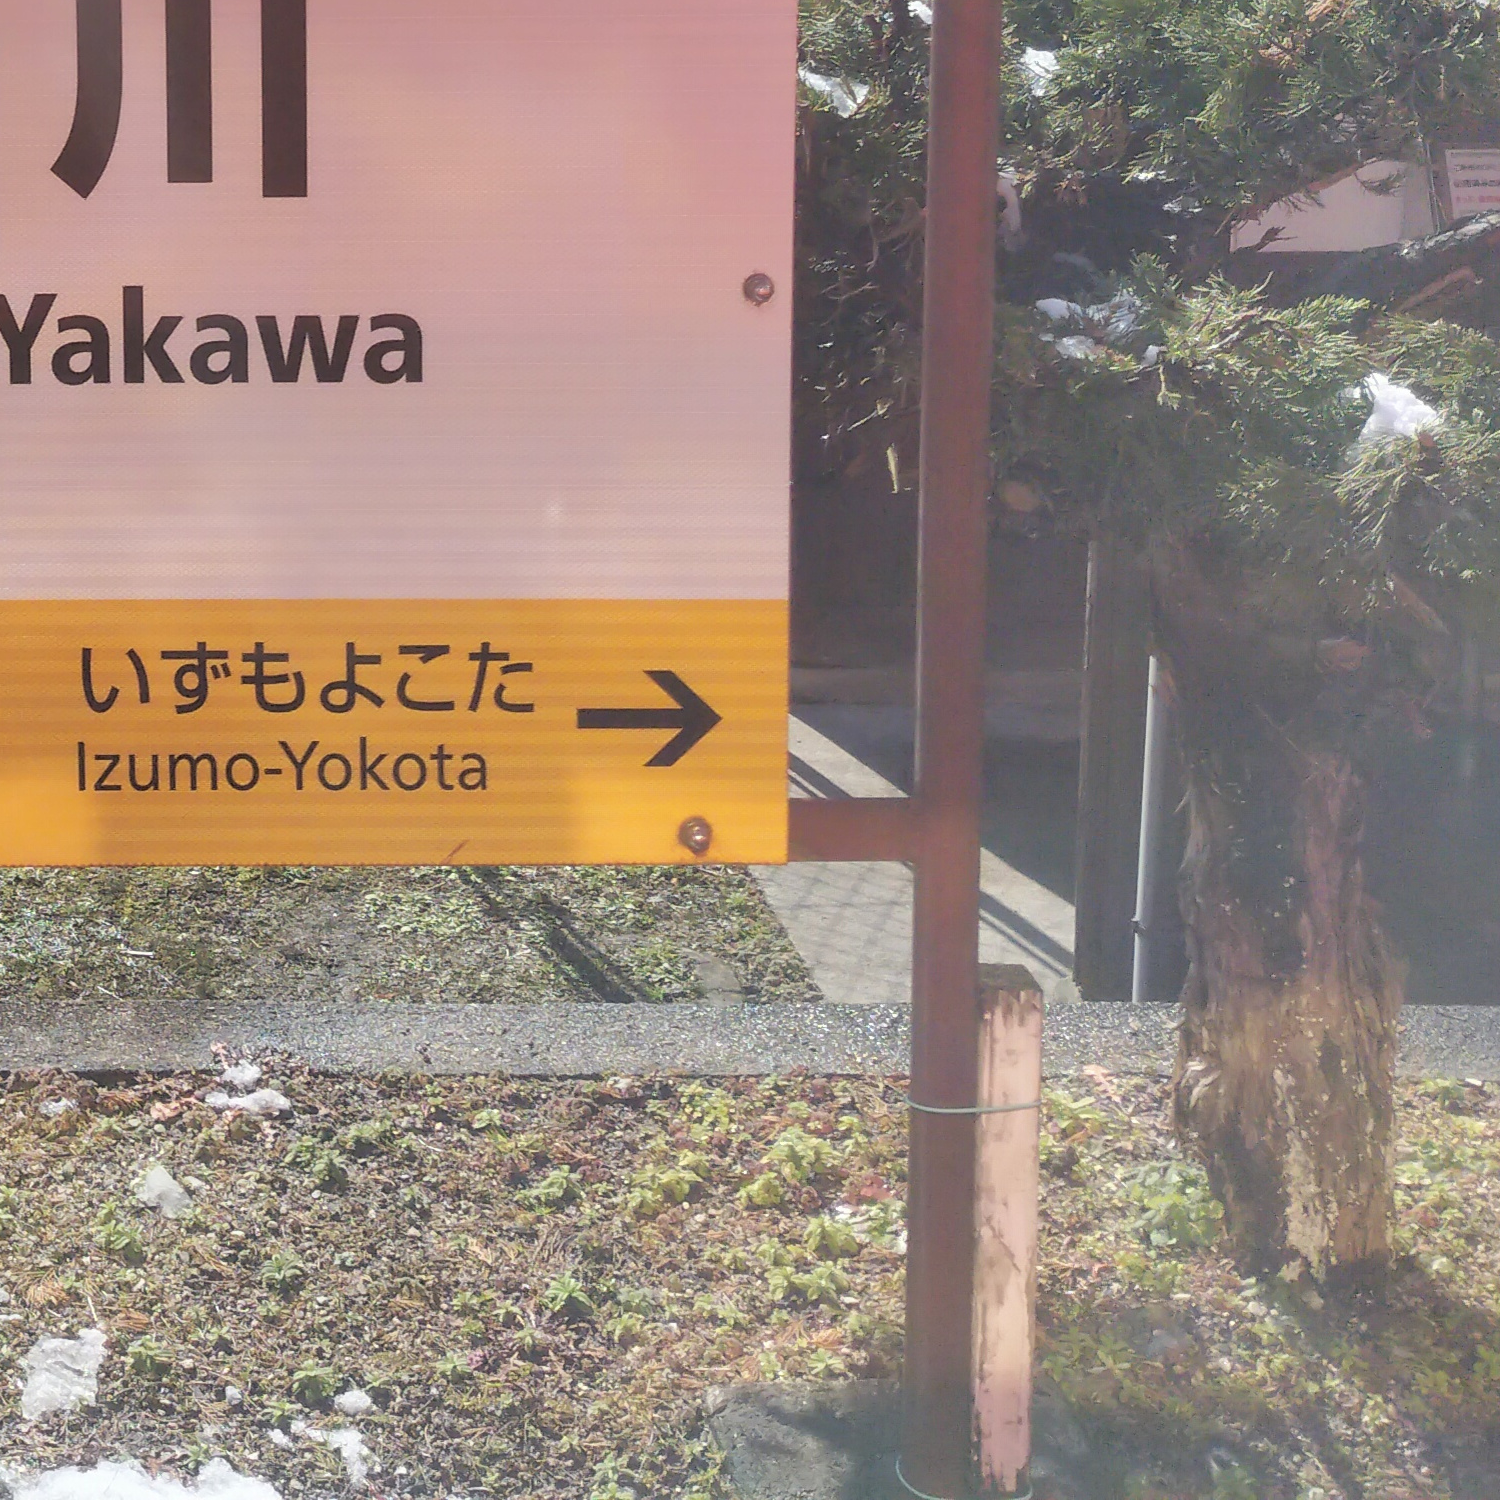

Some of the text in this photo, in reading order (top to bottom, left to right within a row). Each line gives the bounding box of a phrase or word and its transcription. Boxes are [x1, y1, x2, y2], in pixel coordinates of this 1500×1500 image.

[81, 641, 536, 715] いずもよこた
[77, 736, 488, 792] Izumo-Yokota
